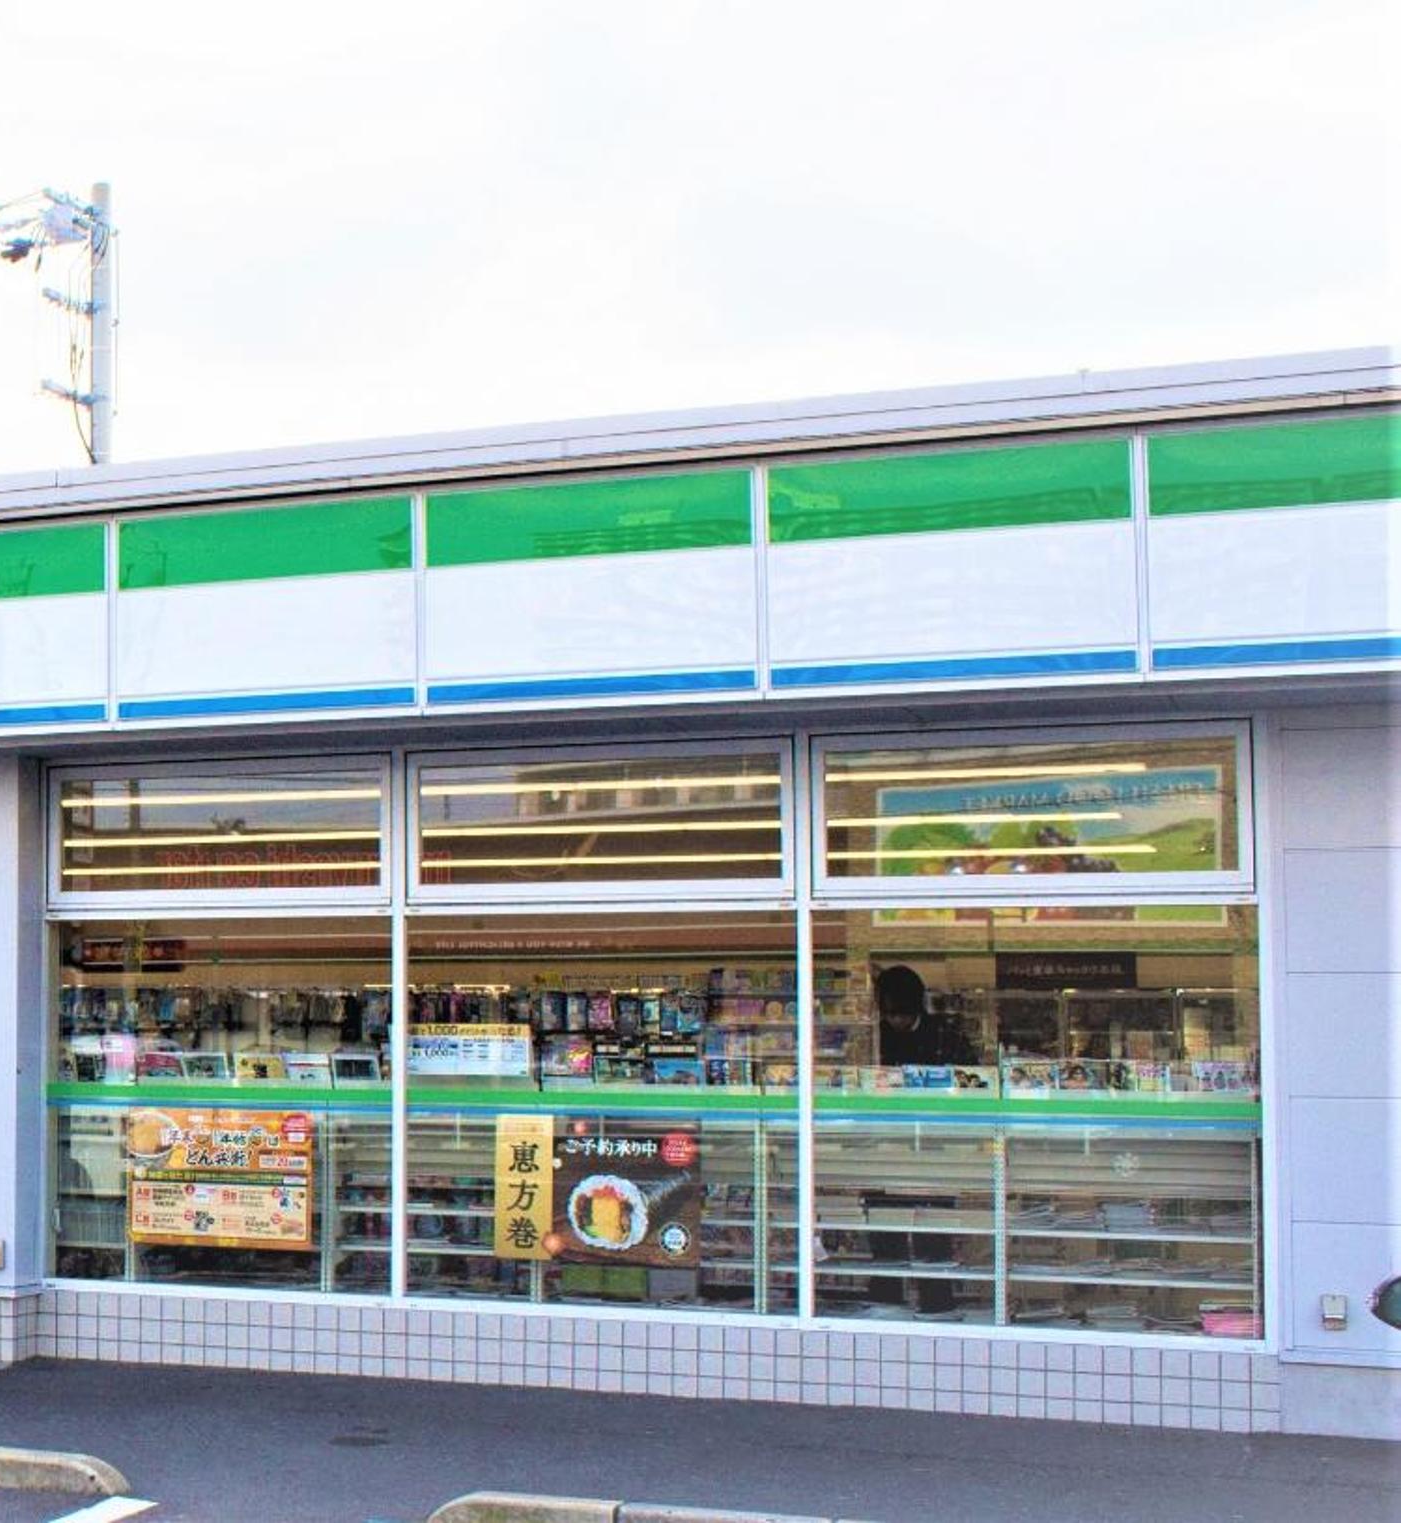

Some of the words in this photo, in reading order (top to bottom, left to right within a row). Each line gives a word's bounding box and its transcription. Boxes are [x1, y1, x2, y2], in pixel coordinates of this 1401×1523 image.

[565, 1138, 658, 1158] ご予約承り中
[505, 1141, 541, 1249] 恵方巻
